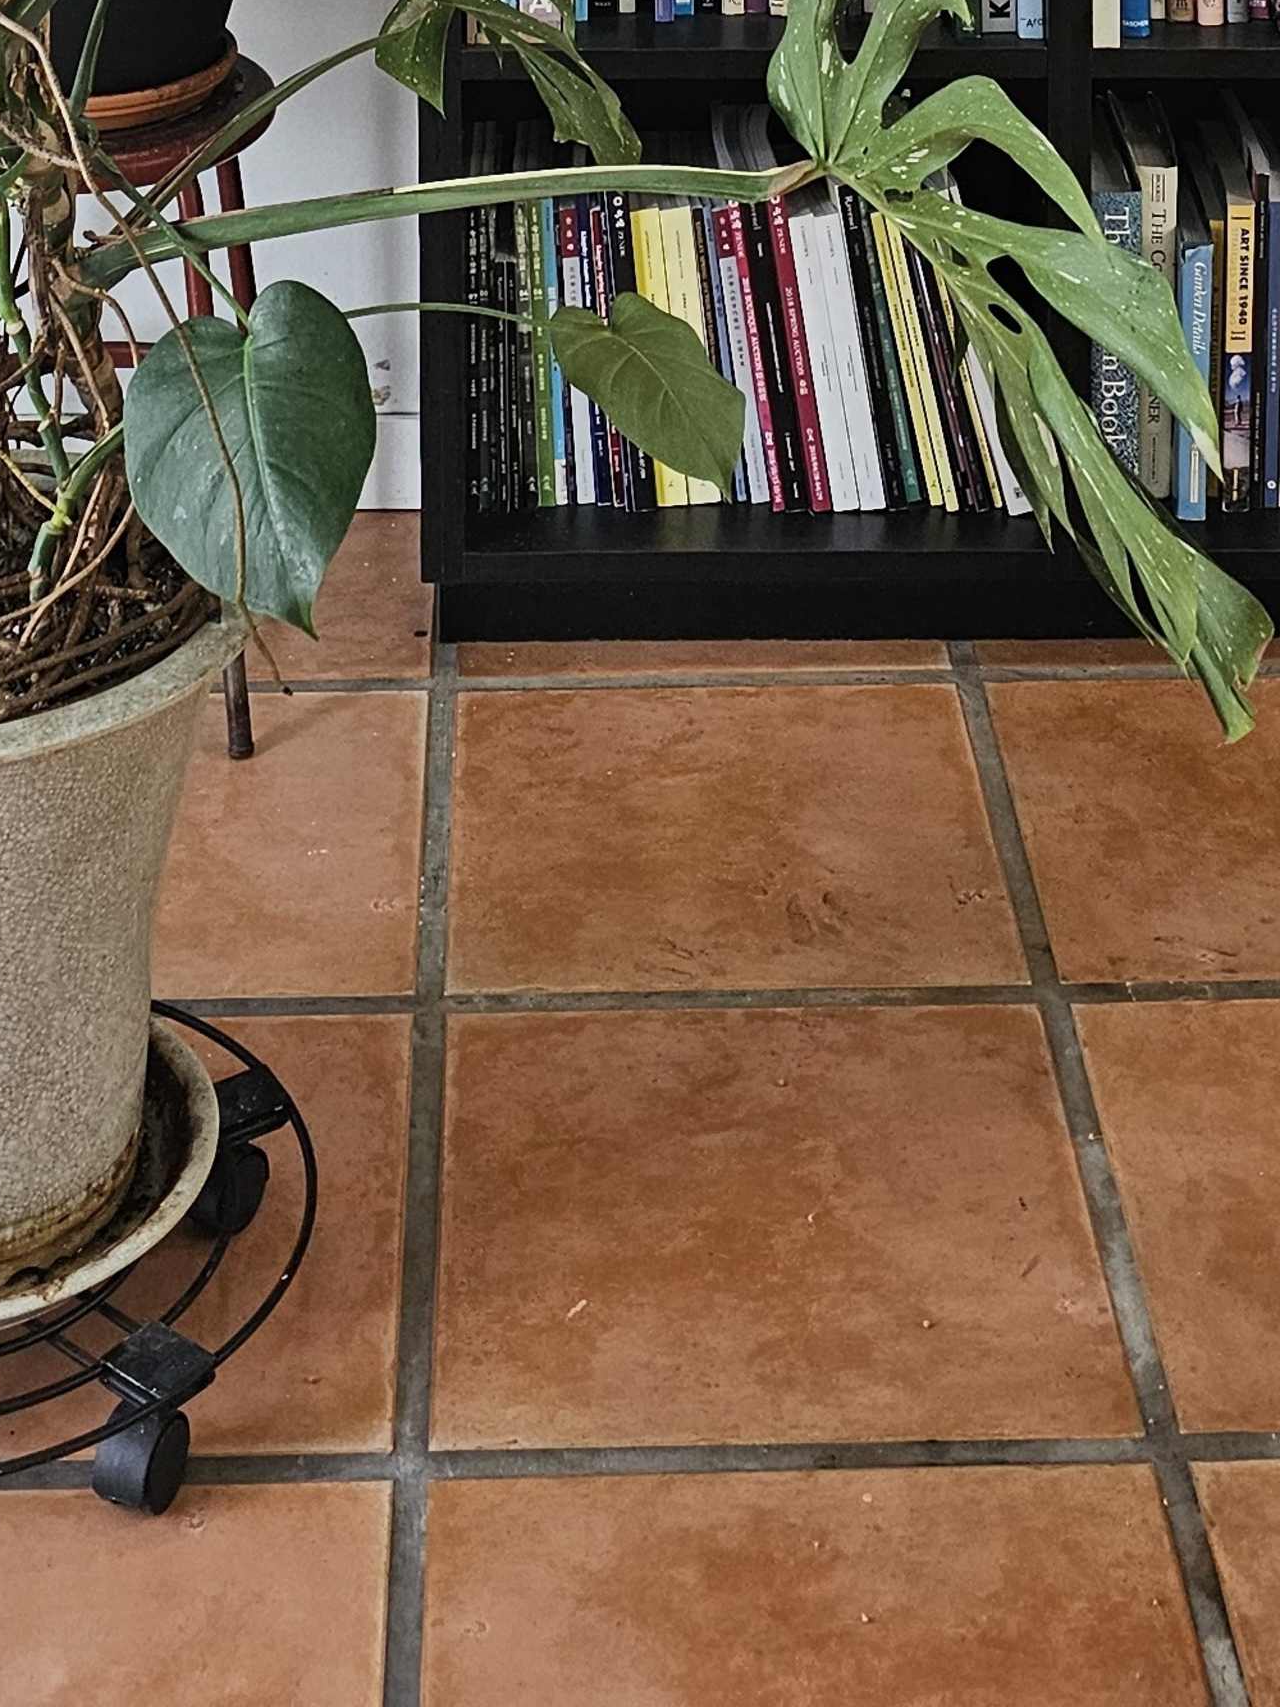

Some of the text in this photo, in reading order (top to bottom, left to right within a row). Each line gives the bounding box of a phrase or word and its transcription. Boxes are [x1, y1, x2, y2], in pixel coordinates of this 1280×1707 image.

[1238, 228, 1251, 325] ART SINCE 1940
